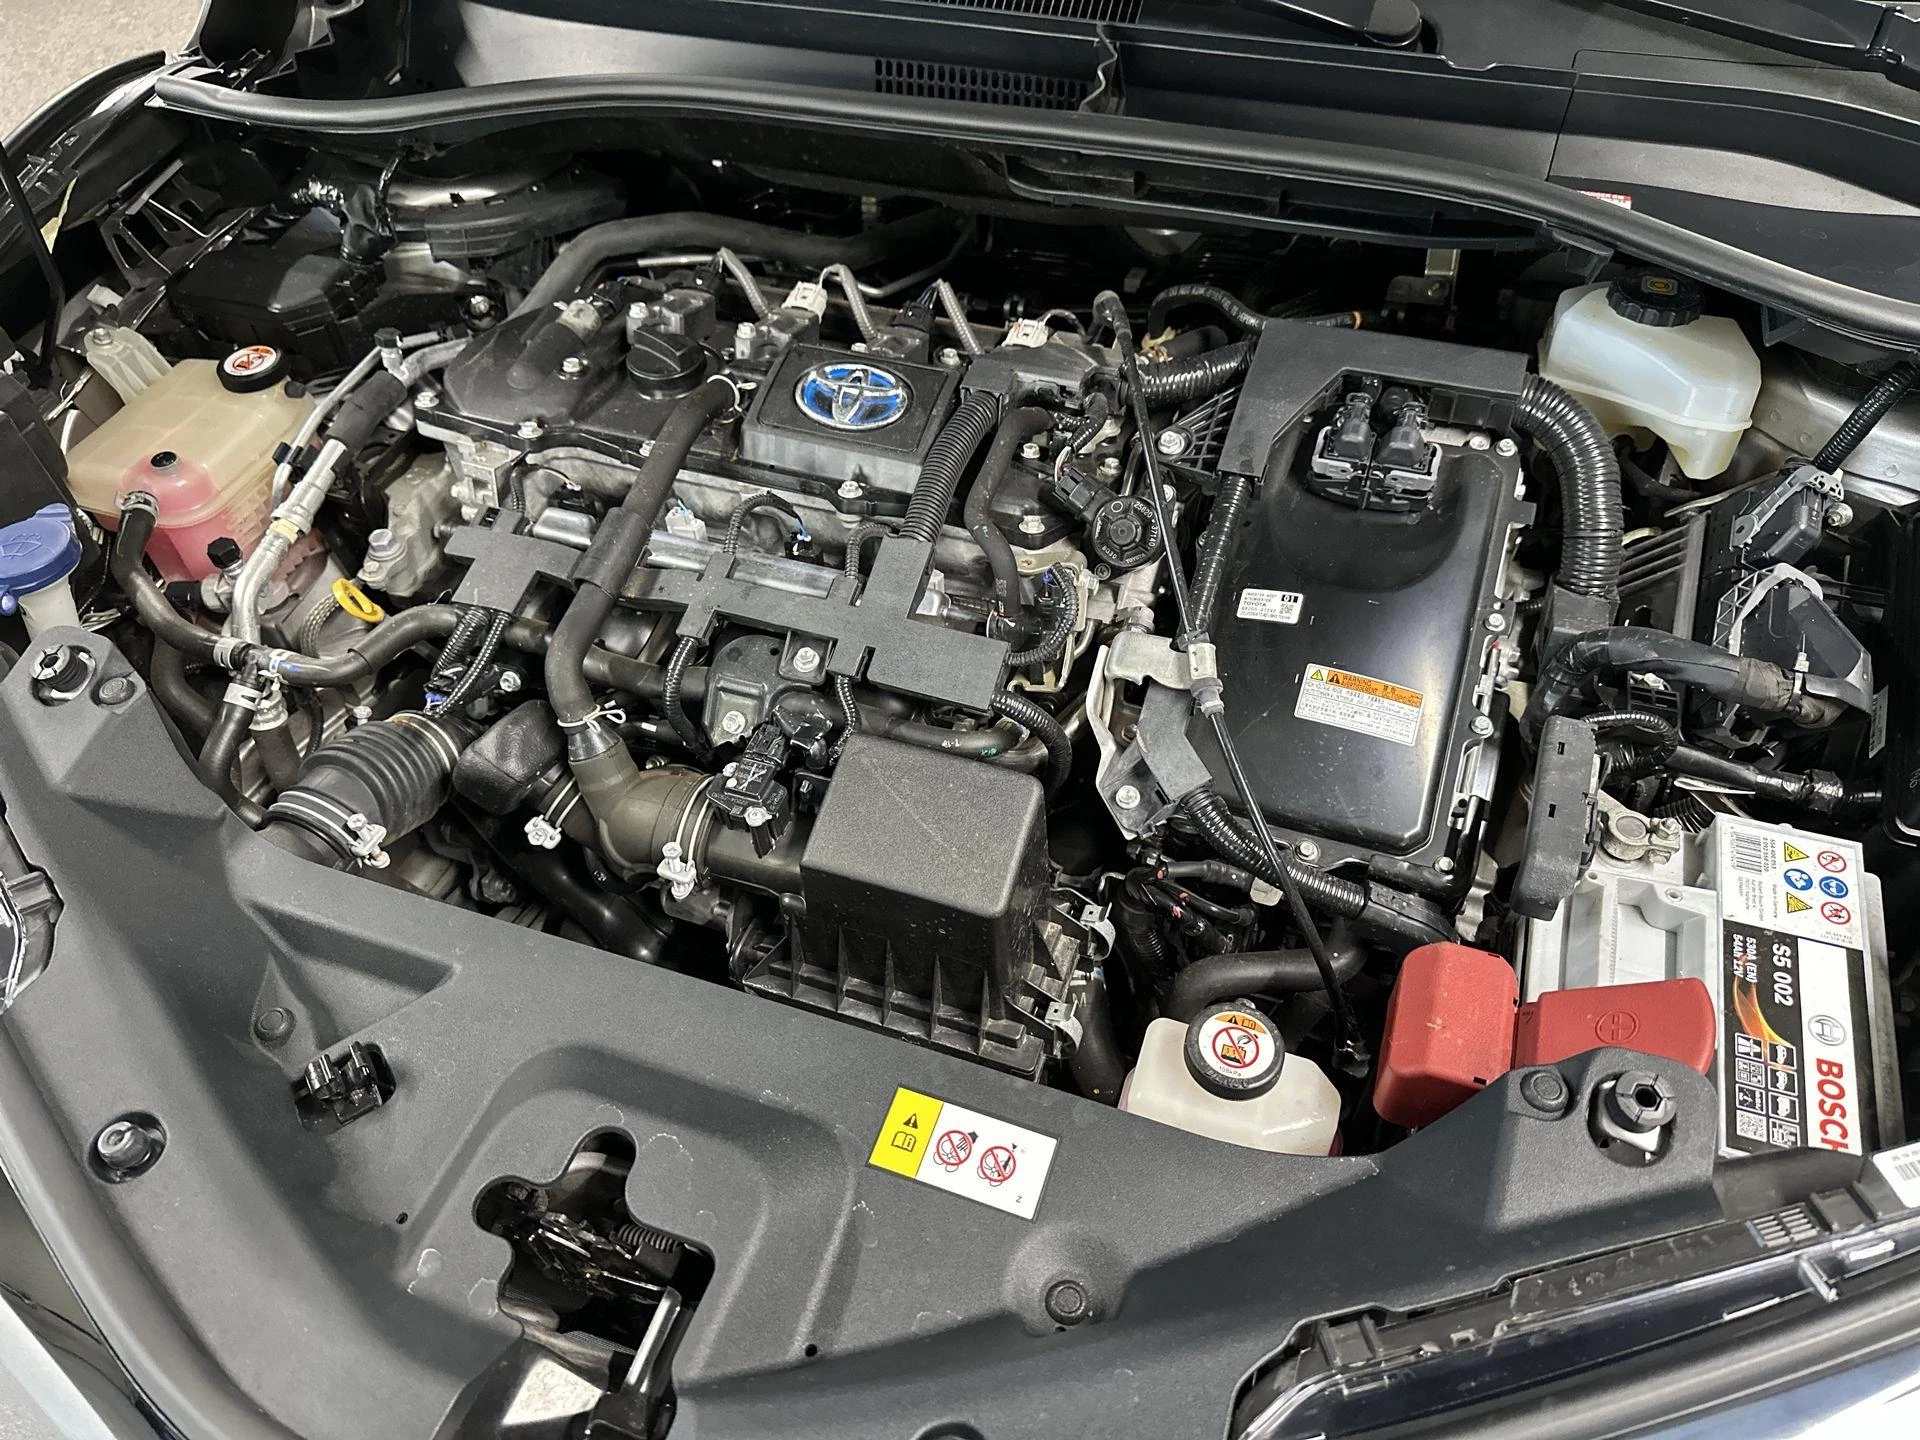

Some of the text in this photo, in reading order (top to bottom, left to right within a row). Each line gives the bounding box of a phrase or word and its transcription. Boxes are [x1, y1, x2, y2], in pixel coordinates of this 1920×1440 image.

[1125, 552, 1146, 564] TOYOTA
[1342, 674, 1372, 687] WARNING
[1732, 933, 1744, 978] 54Ah 12V
[1745, 936, 1758, 983] 530A (EN)
[1772, 943, 1794, 1007] S5 002
